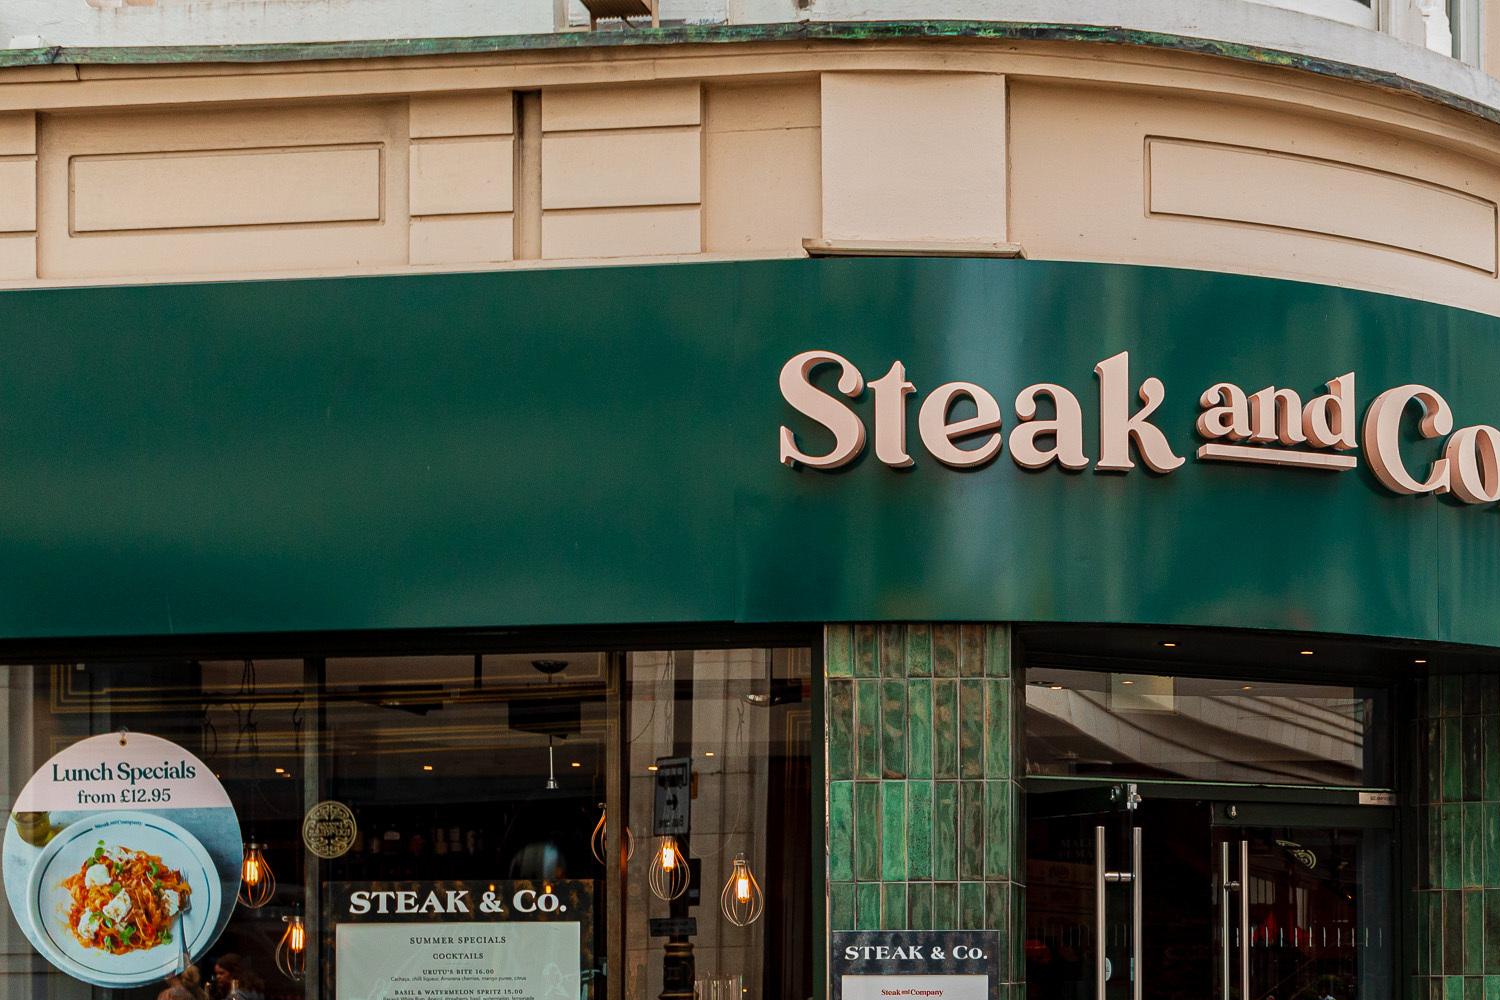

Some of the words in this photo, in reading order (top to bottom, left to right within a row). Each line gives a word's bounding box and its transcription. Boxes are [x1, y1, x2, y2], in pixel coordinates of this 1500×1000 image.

[779, 349, 1186, 475] Steak
[1198, 371, 1358, 455] and
[52, 762, 113, 782] Lunch
[117, 760, 196, 785] Specials
[78, 790, 116, 804] from
[120, 788, 171, 803] £12.95
[349, 889, 470, 914] STEAK
[479, 891, 504, 913] &
[513, 889, 567, 913] Co.
[410, 936, 454, 945] SUMMER
[458, 936, 506, 944] SPECIALS
[433, 952, 484, 960] COCKTAILS
[844, 945, 924, 961] STEAK
[931, 946, 946, 960] &
[952, 945, 988, 960] Co.
[881, 988, 901, 996] Steak
[911, 988, 944, 997] Company
